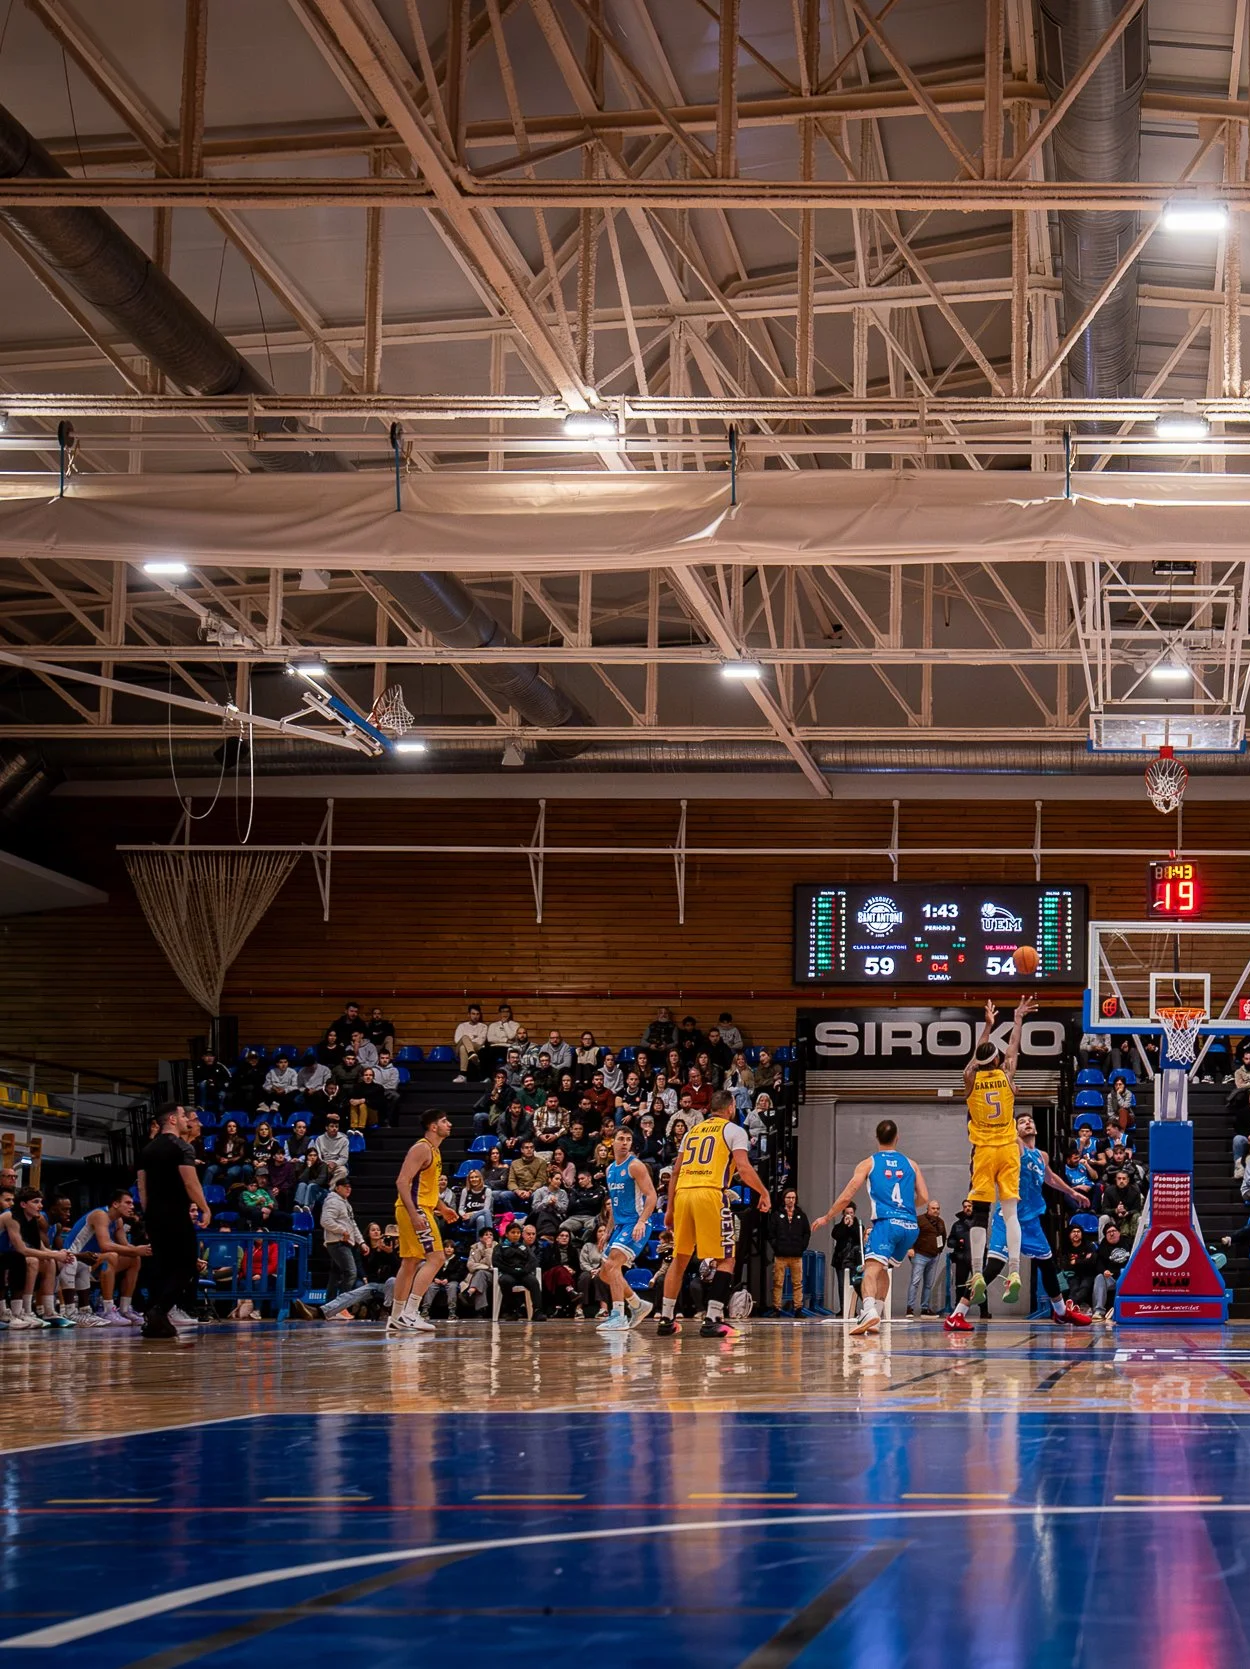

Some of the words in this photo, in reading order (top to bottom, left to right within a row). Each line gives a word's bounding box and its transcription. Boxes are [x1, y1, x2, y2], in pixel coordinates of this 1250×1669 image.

[1165, 882, 1193, 910] 19
[922, 903, 959, 918] 1:43
[981, 918, 1022, 932] UEM
[915, 954, 923, 962] 5
[958, 954, 965, 962] 5
[864, 957, 895, 975] 59
[931, 963, 948, 971] 0-4
[985, 957, 1017, 975] 54
[814, 1021, 1066, 1056] SIROKO
[975, 1080, 1008, 1090] GARRIDO
[985, 1091, 1001, 1119] 5
[683, 1135, 716, 1165] 50
[1153, 1175, 1190, 1183] #somsport
[1153, 1182, 1190, 1190] #somsport
[891, 1182, 904, 1208] 4
[1153, 1189, 1190, 1197] #somsport
[720, 1207, 735, 1247] UEM
[1152, 1277, 1190, 1288] PALAU
